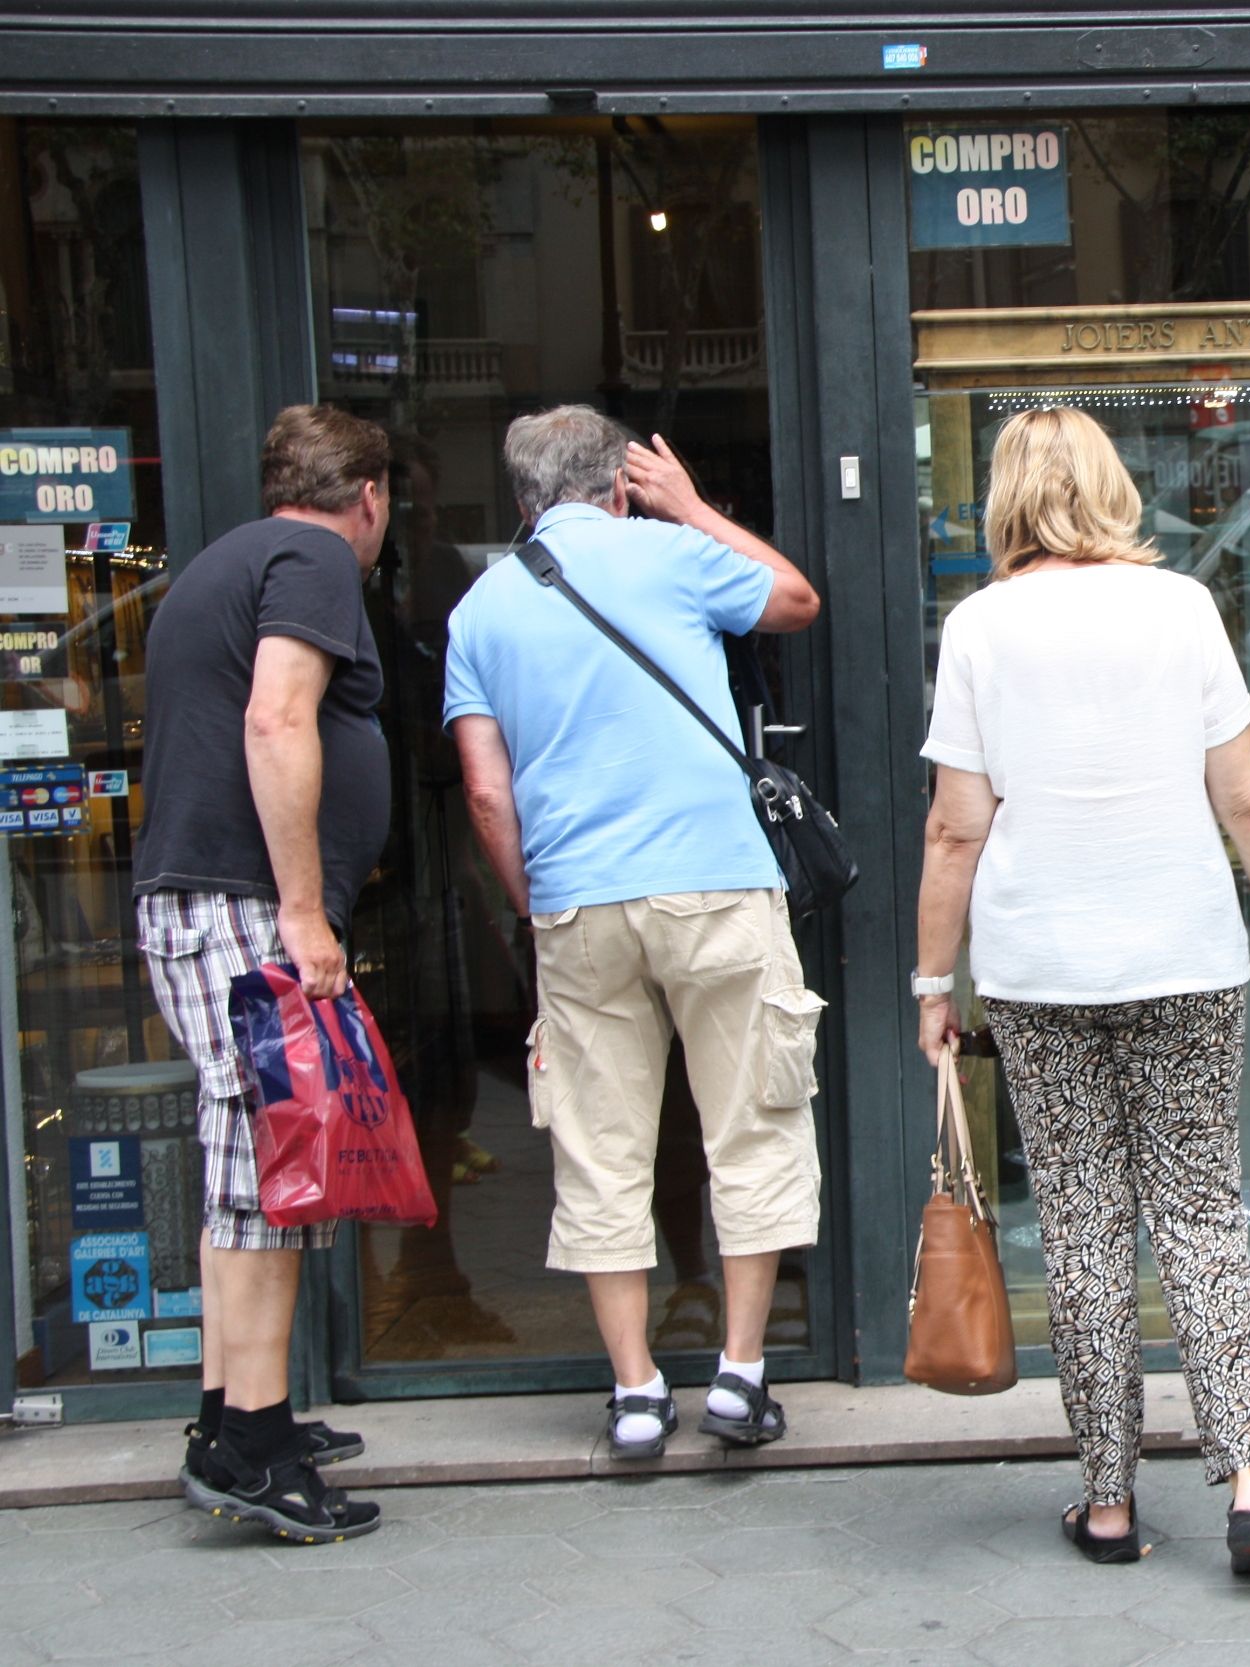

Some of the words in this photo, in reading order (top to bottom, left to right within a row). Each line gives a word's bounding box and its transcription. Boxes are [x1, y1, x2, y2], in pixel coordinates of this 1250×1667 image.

[910, 131, 1059, 174] COMPRO
[956, 186, 1028, 226] ORO
[1062, 320, 1175, 350] JOIERS
[0, 445, 117, 475] COMPRO
[36, 484, 94, 512] ORO
[20, 656, 42, 674] OR
[33, 811, 57, 822] VISA
[80, 1232, 139, 1247] ASSOCIACIÓ
[73, 1246, 116, 1260] GALERIES
[118, 1246, 145, 1258] D'ART
[79, 1311, 91, 1322] DE
[92, 1308, 146, 1321] CATALUNYA
